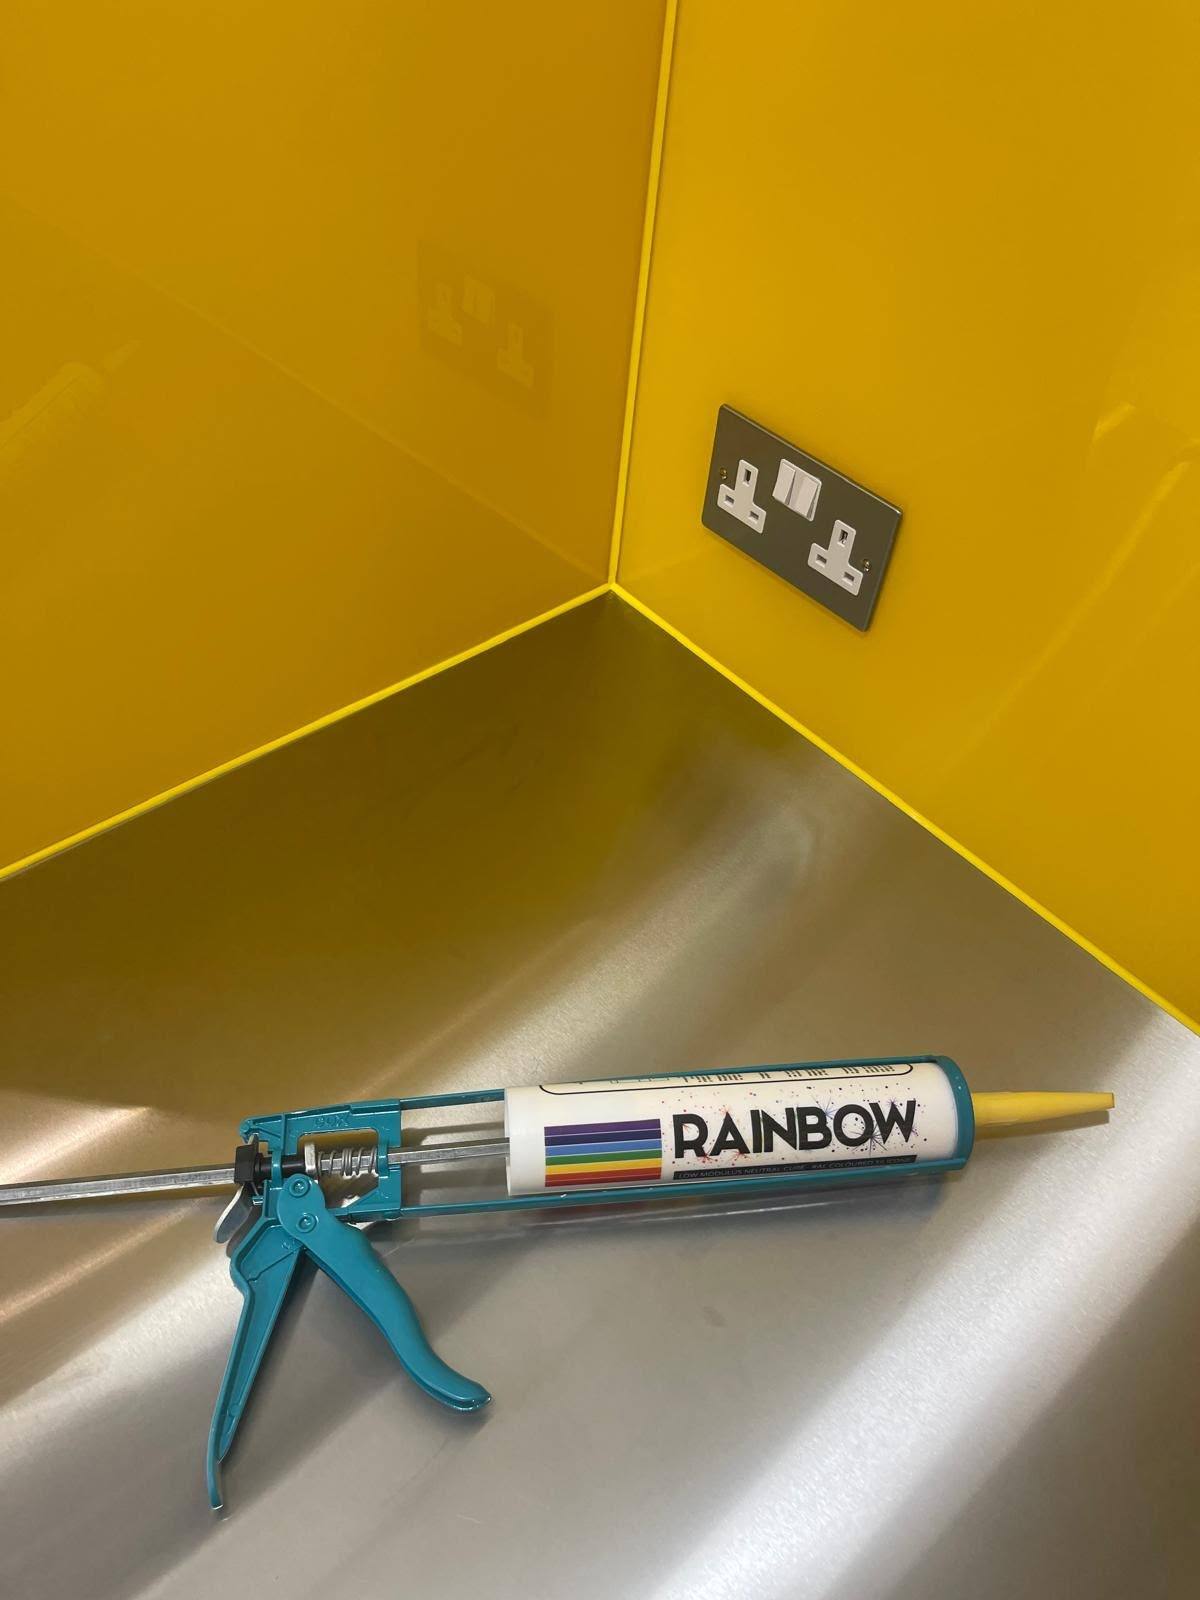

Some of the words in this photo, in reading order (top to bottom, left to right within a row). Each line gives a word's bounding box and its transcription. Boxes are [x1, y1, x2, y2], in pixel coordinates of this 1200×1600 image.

[672, 1100, 916, 1158] RAINBOW
[678, 1171, 699, 1179] LOW
[700, 1168, 743, 1177] MODULUS
